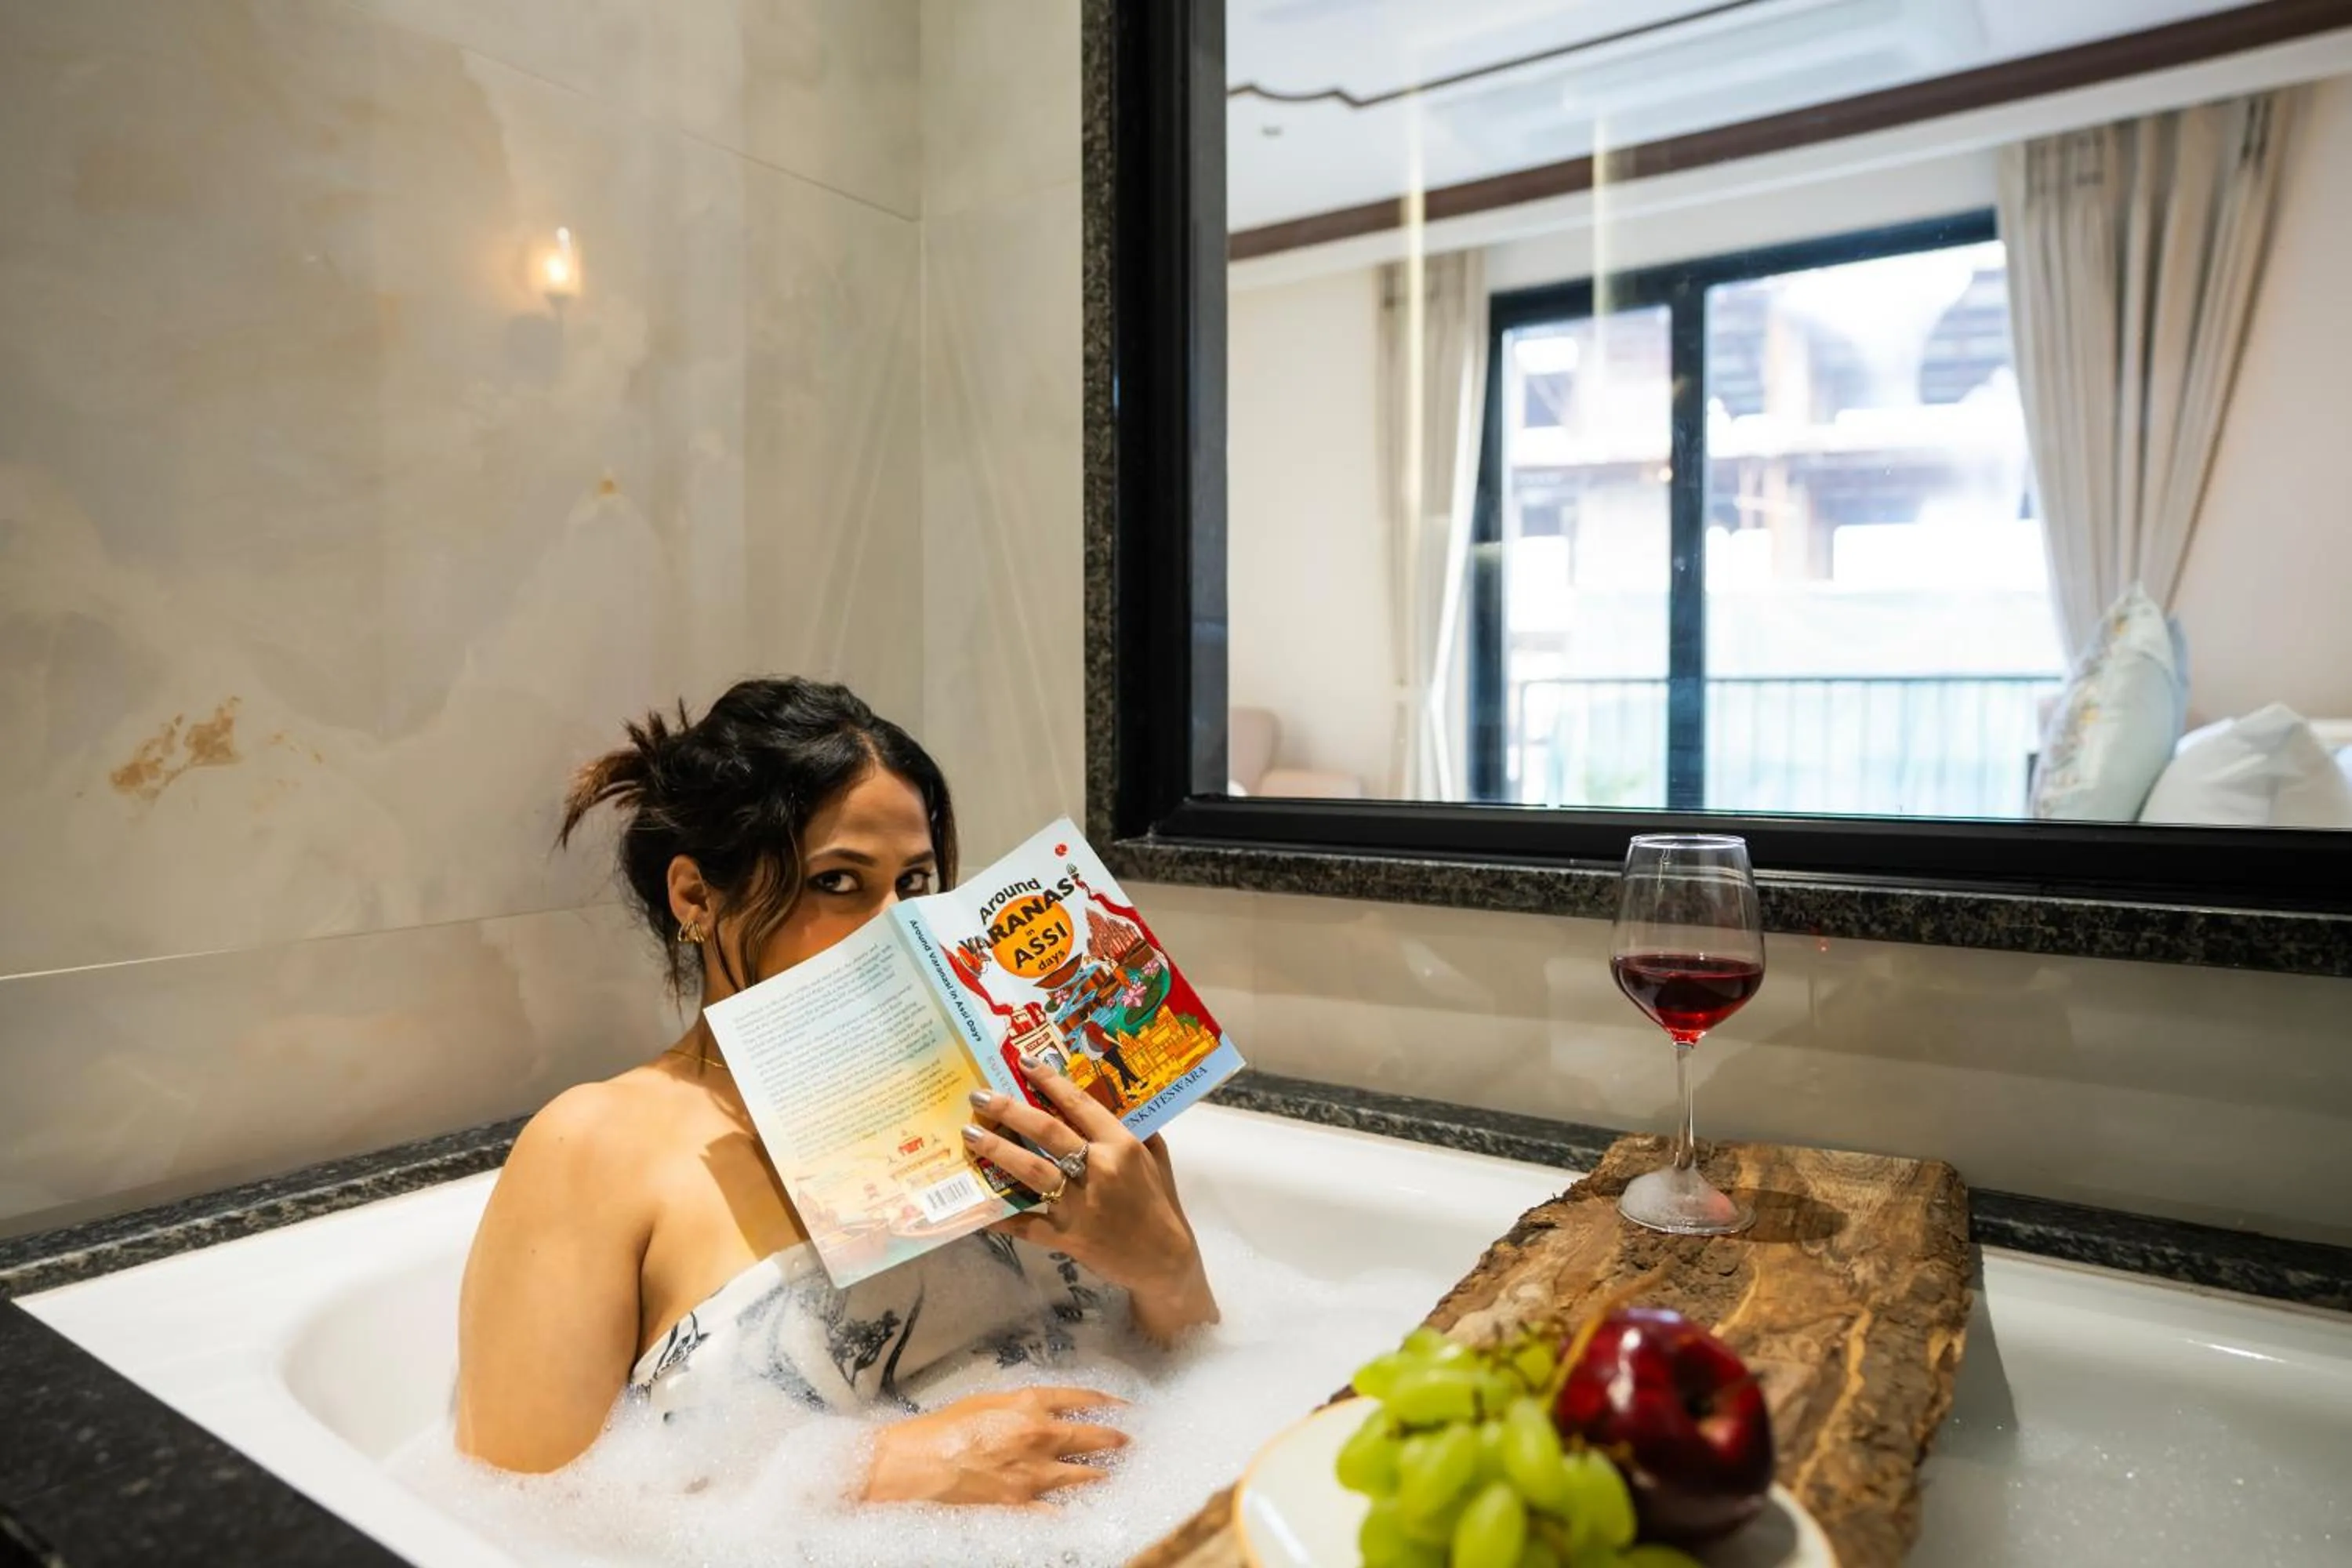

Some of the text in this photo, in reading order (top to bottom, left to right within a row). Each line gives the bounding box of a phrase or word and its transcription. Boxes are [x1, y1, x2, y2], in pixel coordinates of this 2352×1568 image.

[979, 877, 1041, 925] Around
[1014, 921, 1068, 968] ASSI
[1025, 928, 1036, 937] in
[909, 919, 982, 1042] Around Varanasi in Assi Days
[1037, 949, 1065, 971] days
